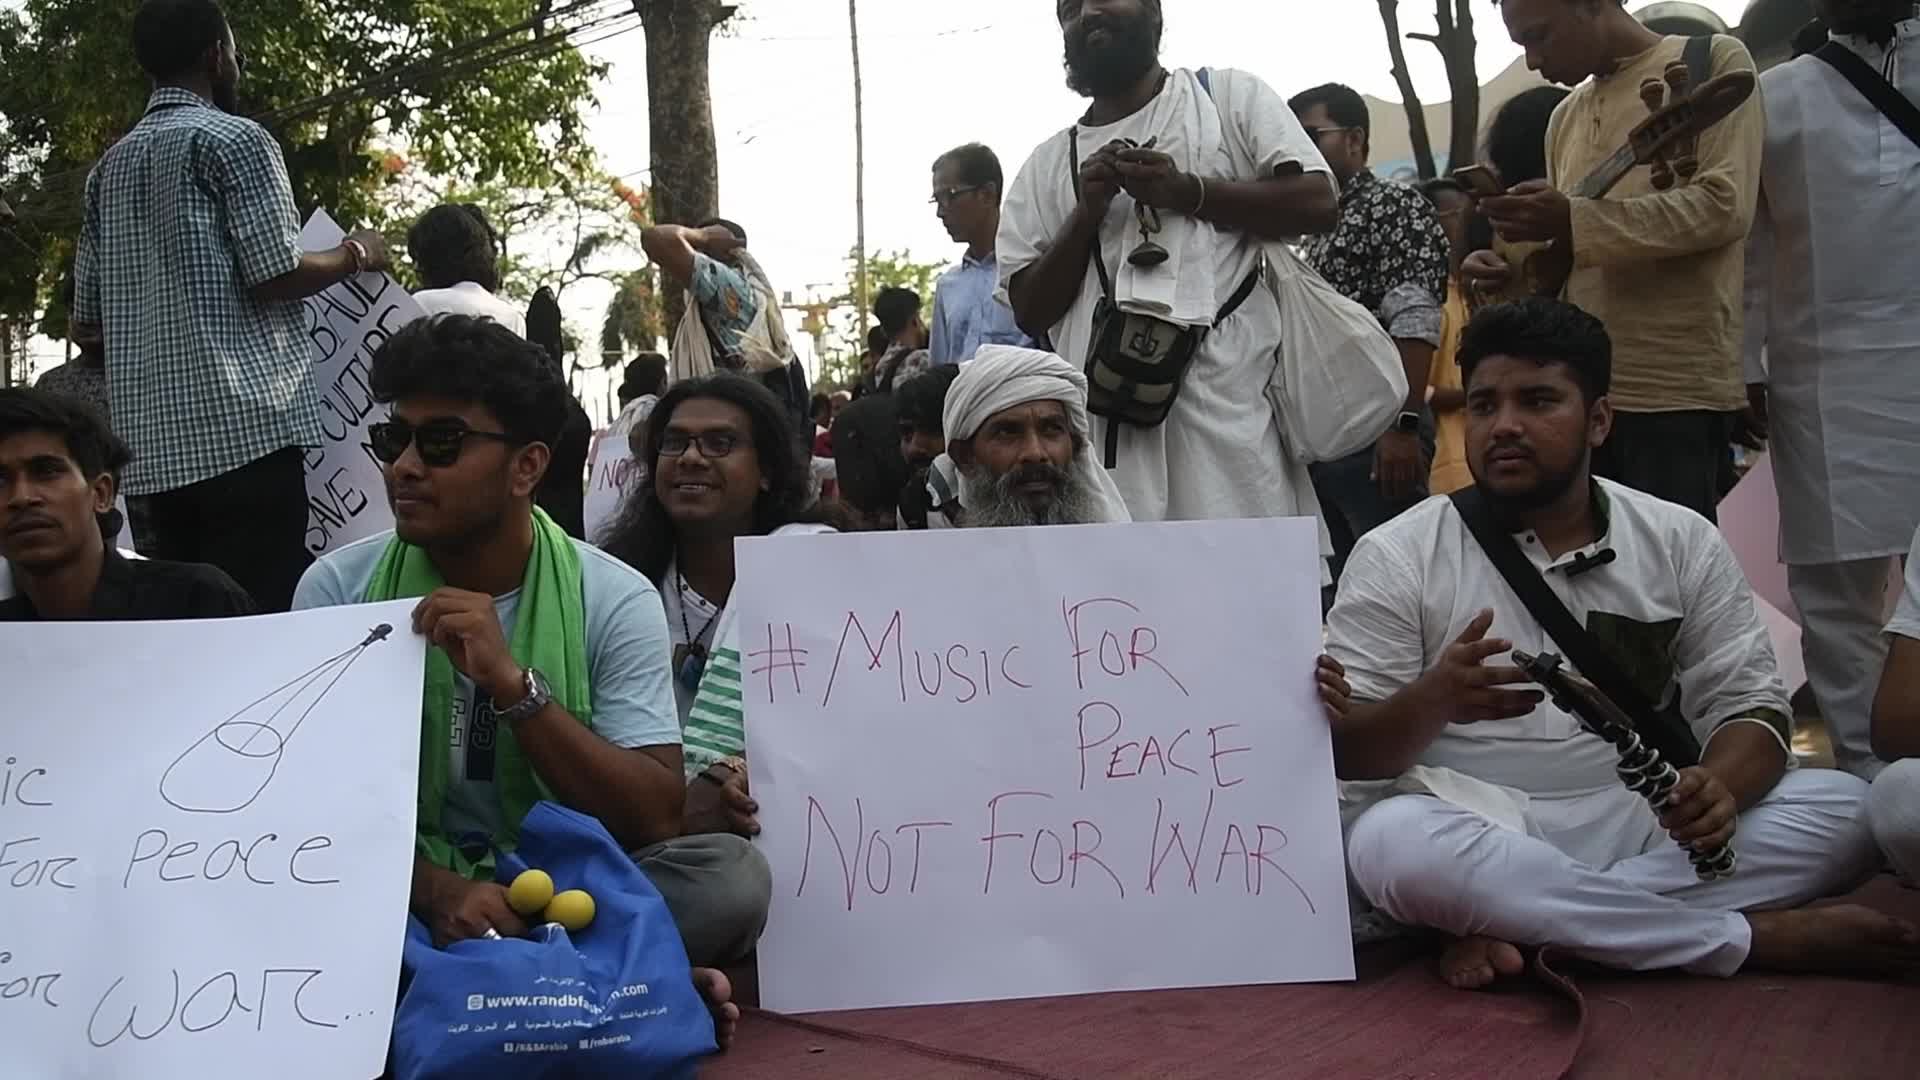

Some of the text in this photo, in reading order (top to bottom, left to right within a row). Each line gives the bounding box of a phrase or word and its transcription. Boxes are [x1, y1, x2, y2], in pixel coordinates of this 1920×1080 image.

[306, 467, 369, 552] SAVE
[1063, 595, 1189, 696] FOR
[1077, 701, 1252, 789] PEACE
[797, 788, 1316, 913] NOT FOR WAR
